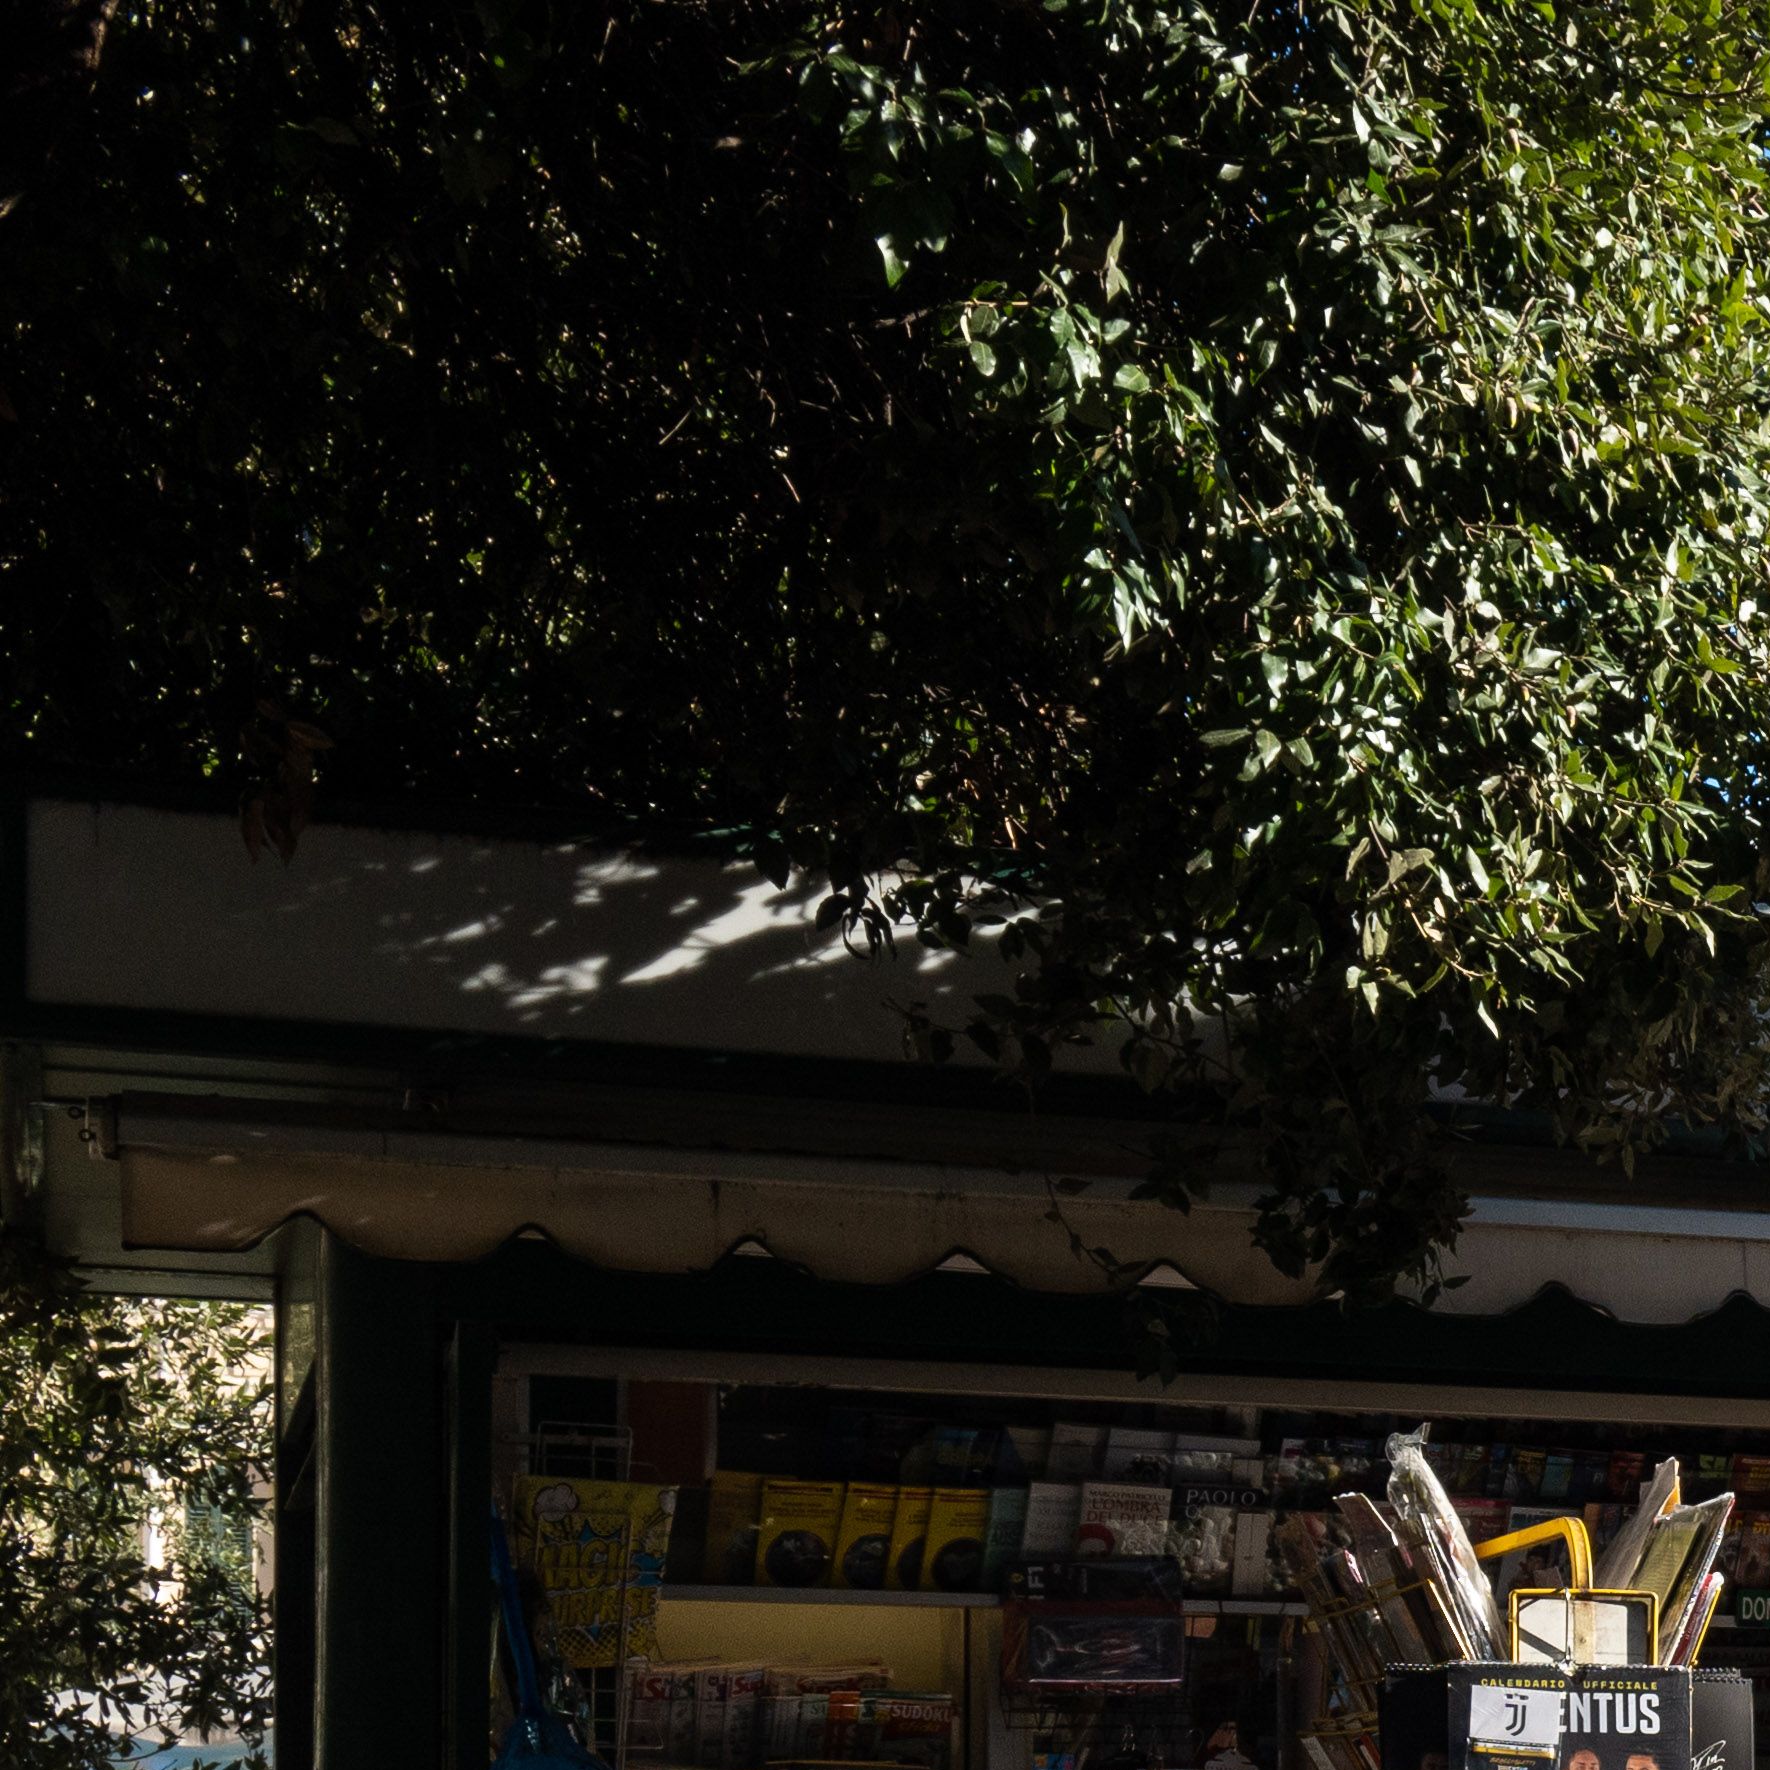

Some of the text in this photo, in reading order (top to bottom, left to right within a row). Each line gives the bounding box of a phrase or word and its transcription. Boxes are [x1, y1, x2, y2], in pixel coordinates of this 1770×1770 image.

[1186, 1489, 1258, 1505] PAOLO
[1481, 1678, 1658, 1691] CALENDARIO UFFICIALE
